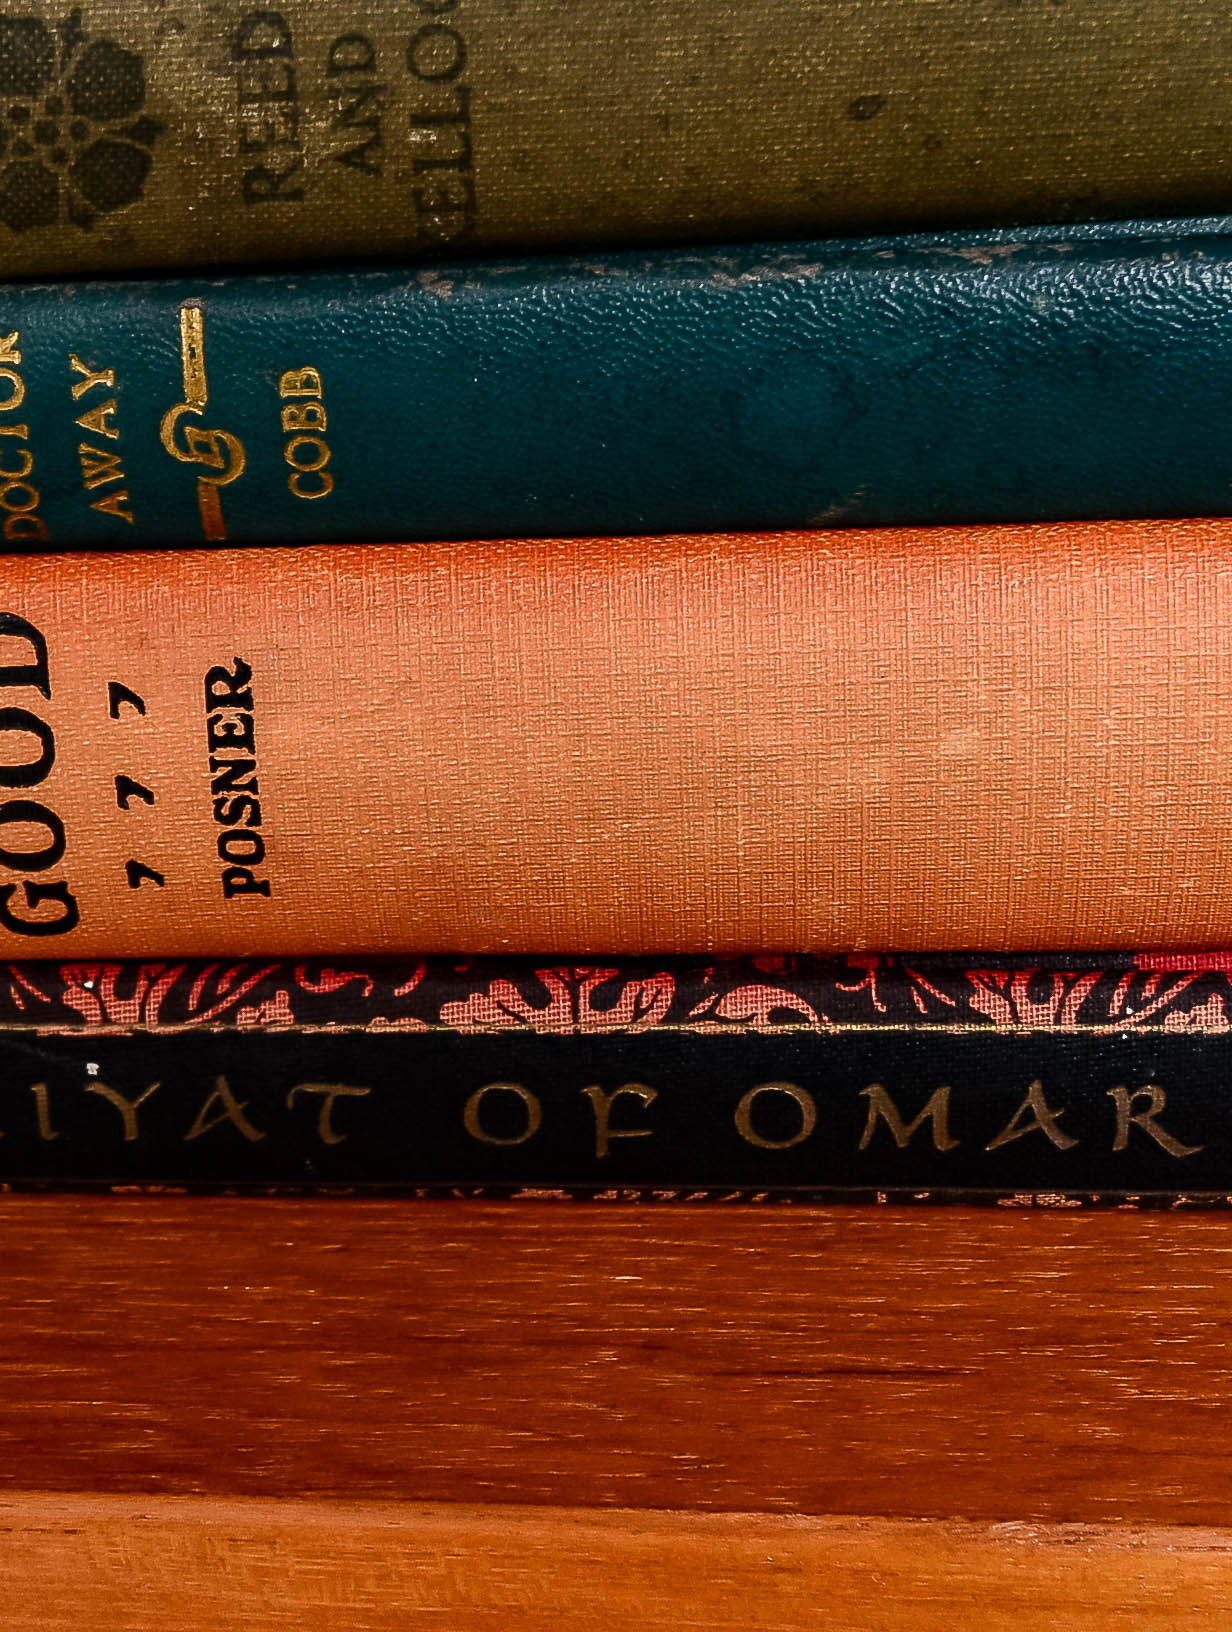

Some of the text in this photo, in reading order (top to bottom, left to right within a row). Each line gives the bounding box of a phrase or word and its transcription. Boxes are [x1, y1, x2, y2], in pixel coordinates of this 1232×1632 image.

[231, 10, 305, 206] REED
[324, 32, 384, 177] AND
[68, 352, 136, 526] AWAY
[278, 364, 336, 501] COBB
[203, 655, 272, 901] POSNER
[462, 1081, 660, 1161] OF
[732, 1078, 1206, 1161] OMAR
